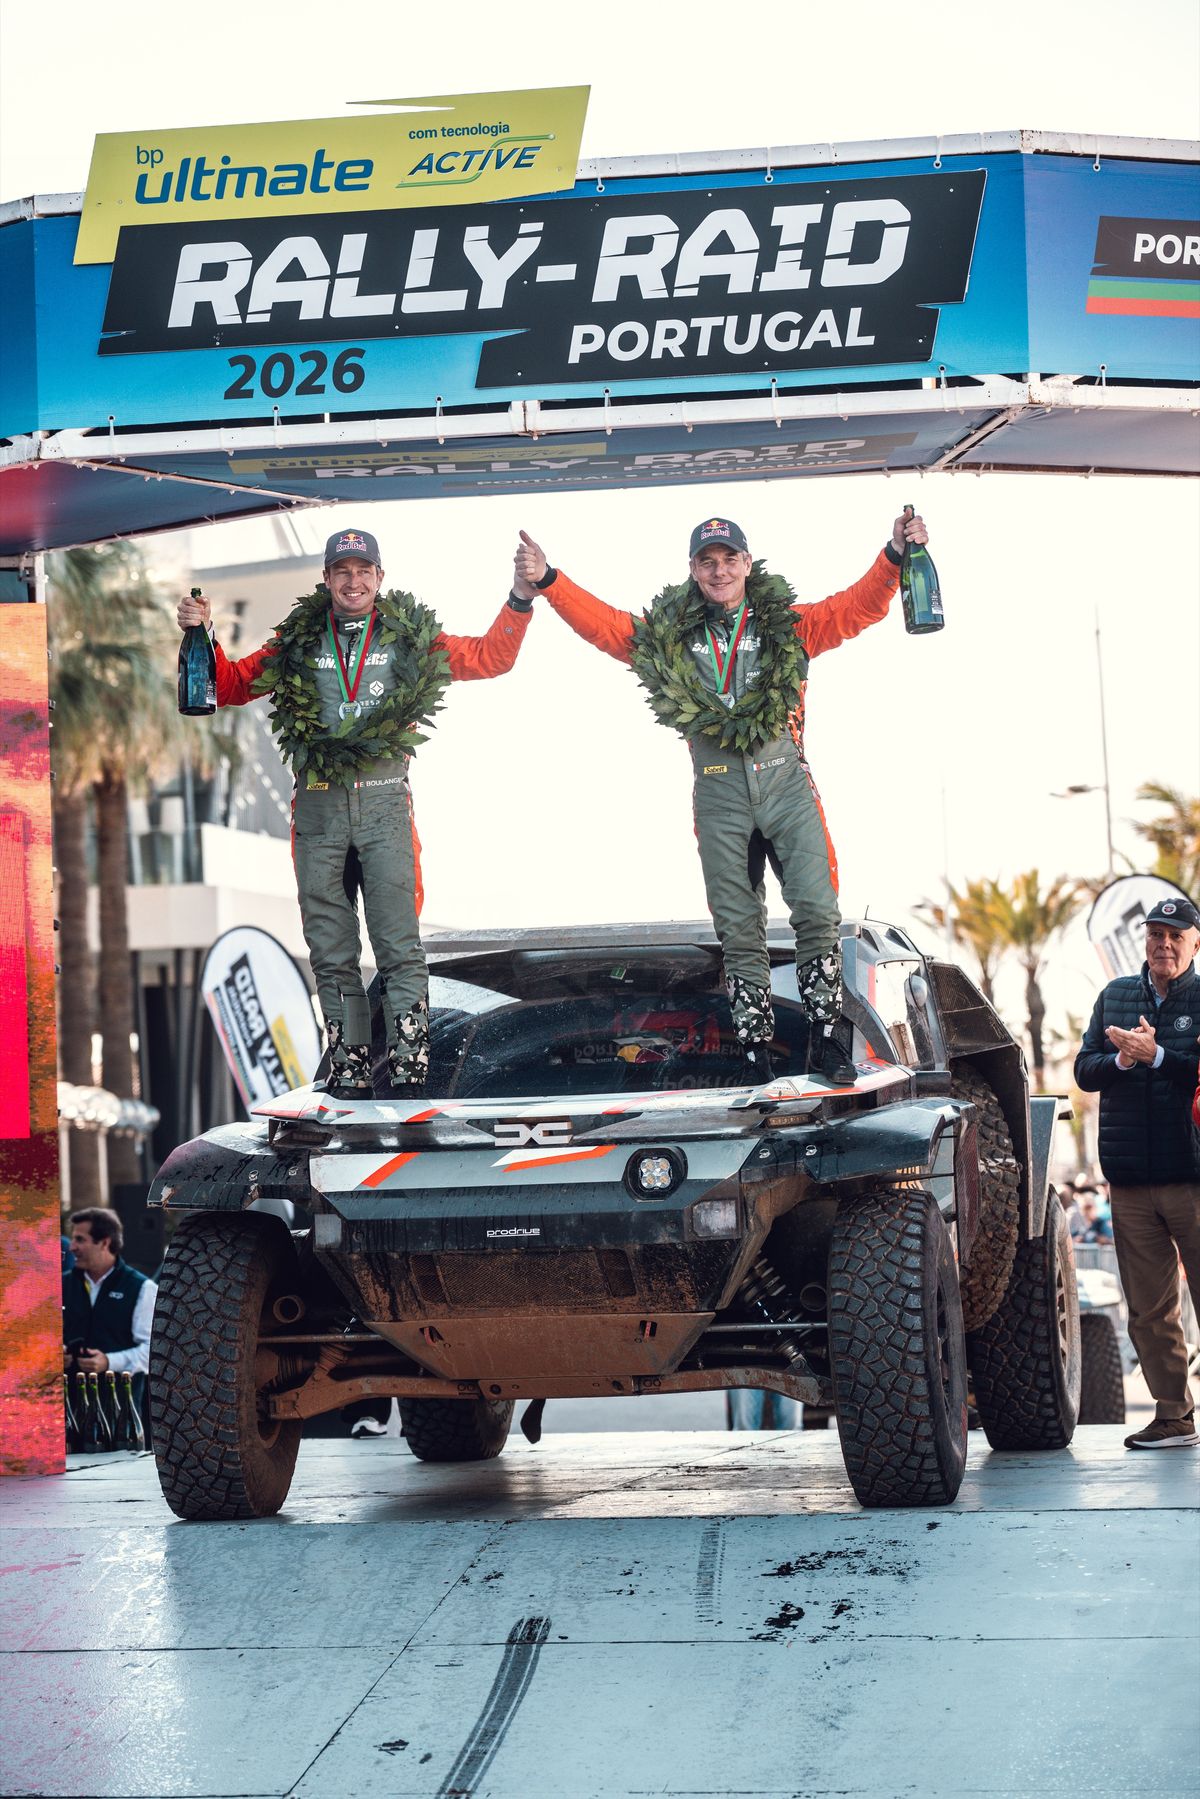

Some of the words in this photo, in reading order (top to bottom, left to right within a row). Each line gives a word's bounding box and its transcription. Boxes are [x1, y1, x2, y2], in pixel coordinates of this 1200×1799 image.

[408, 127, 437, 140] com
[440, 121, 511, 139] tecnologia
[137, 145, 164, 169] bp
[407, 145, 542, 176] ACTIVE
[135, 148, 375, 205] ultimate
[567, 306, 875, 364] PORTUGAL
[223, 348, 366, 400] 2026
[486, 1227, 541, 1238] prodrive
